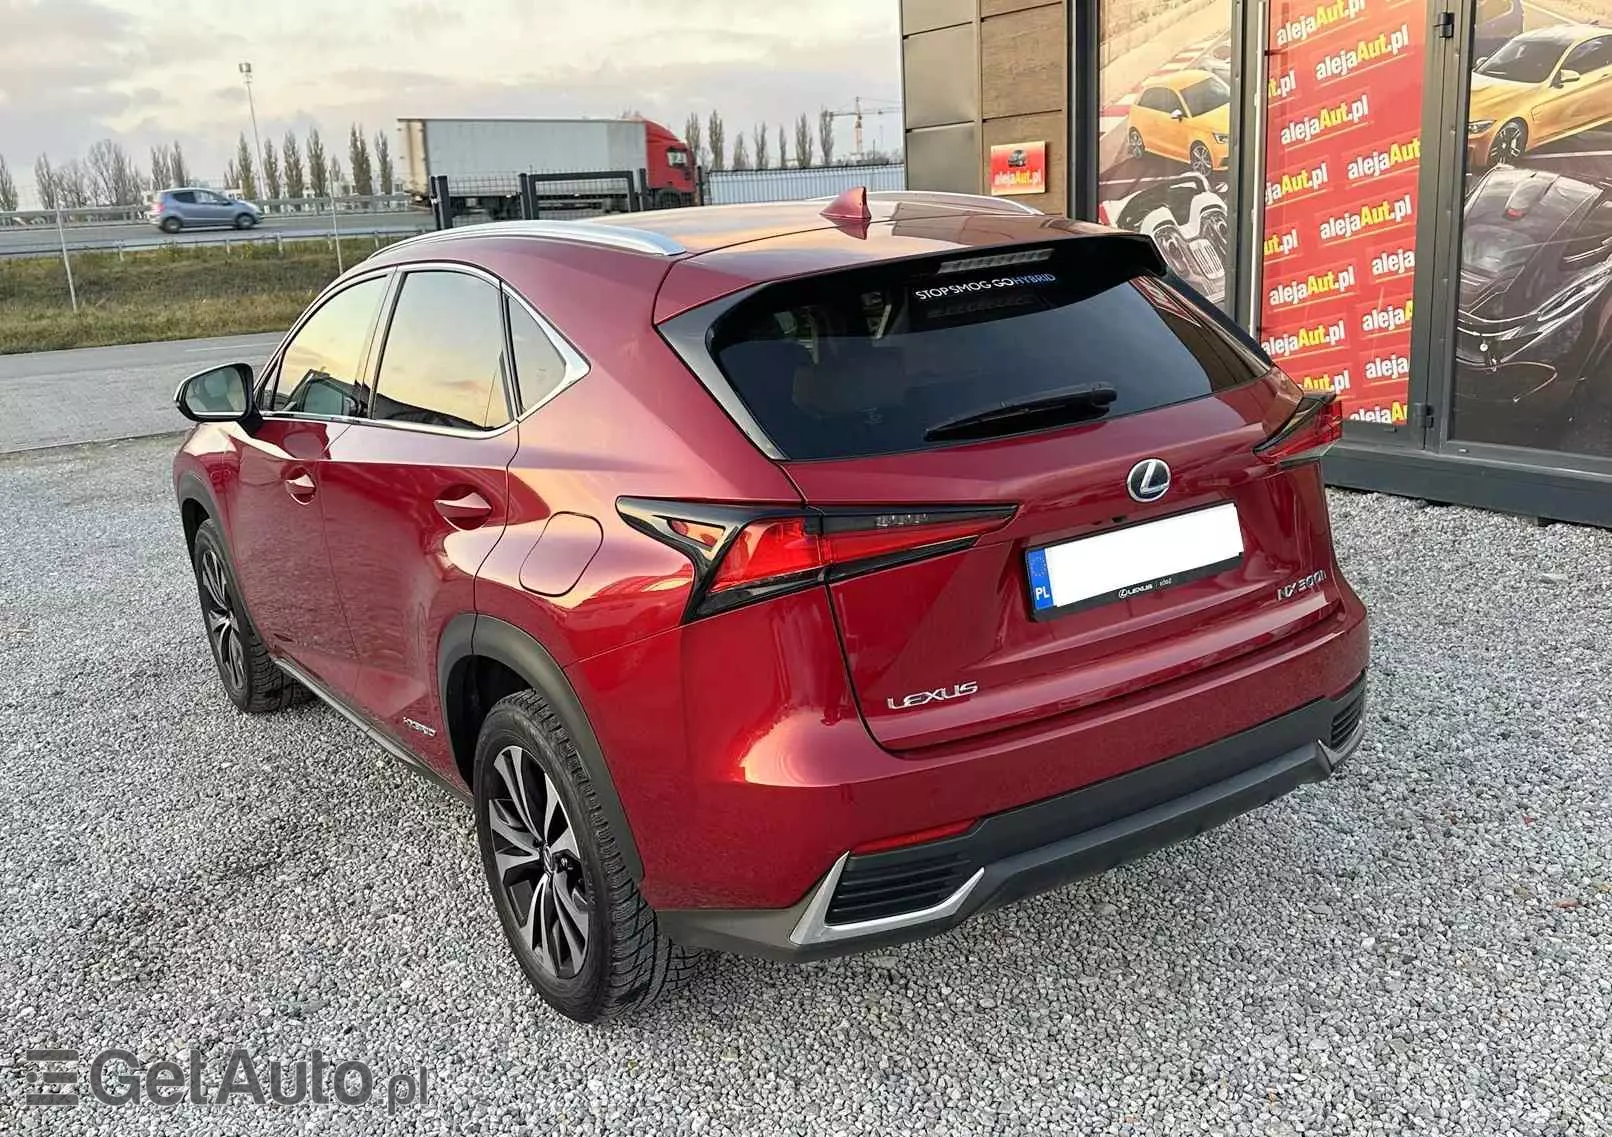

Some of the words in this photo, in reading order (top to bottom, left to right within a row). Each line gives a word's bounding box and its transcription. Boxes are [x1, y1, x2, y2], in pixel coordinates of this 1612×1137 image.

[1315, 24, 1409, 80] alejaAut.pl
[1281, 94, 1369, 145] alejaAut.pl
[1320, 195, 1412, 240] alejaAut.pl
[1269, 266, 1355, 306] alejaAut.pl
[1261, 320, 1345, 357] alejaAut.pl
[1299, 370, 1350, 395] Aut.pl
[1035, 585, 1051, 601] PL
[887, 681, 979, 710] LEXUS
